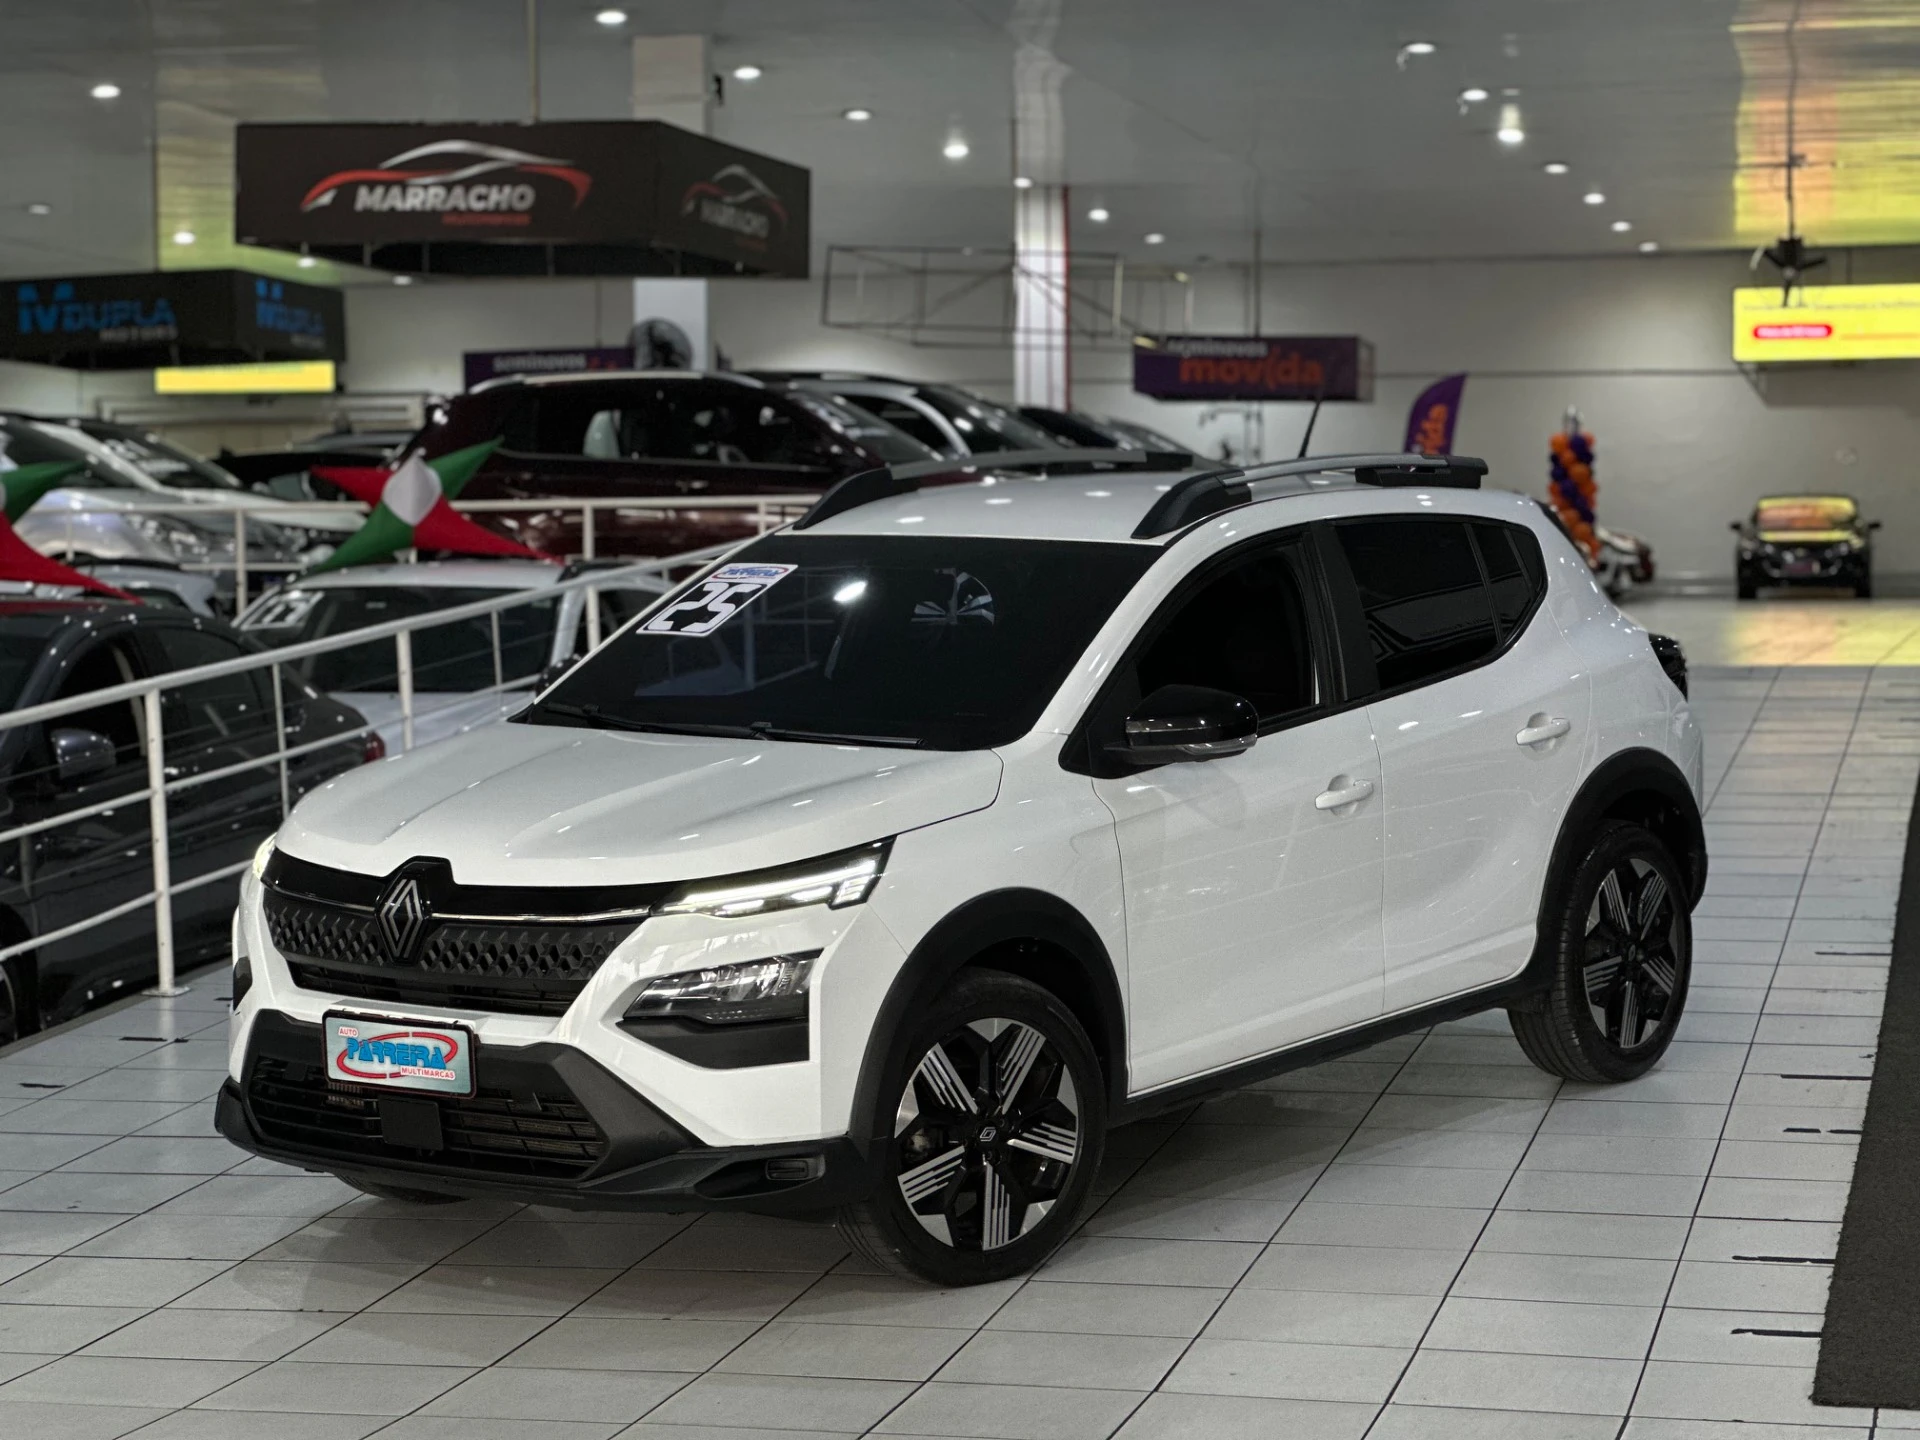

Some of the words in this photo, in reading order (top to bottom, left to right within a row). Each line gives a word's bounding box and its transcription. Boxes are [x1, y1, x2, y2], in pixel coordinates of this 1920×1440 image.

[353, 184, 536, 212] MARRACHO
[647, 582, 763, 633] 25
[339, 1027, 358, 1037] AUTO
[346, 1037, 448, 1070] PARREIRA
[401, 1066, 455, 1080] MULTIMARCAS
